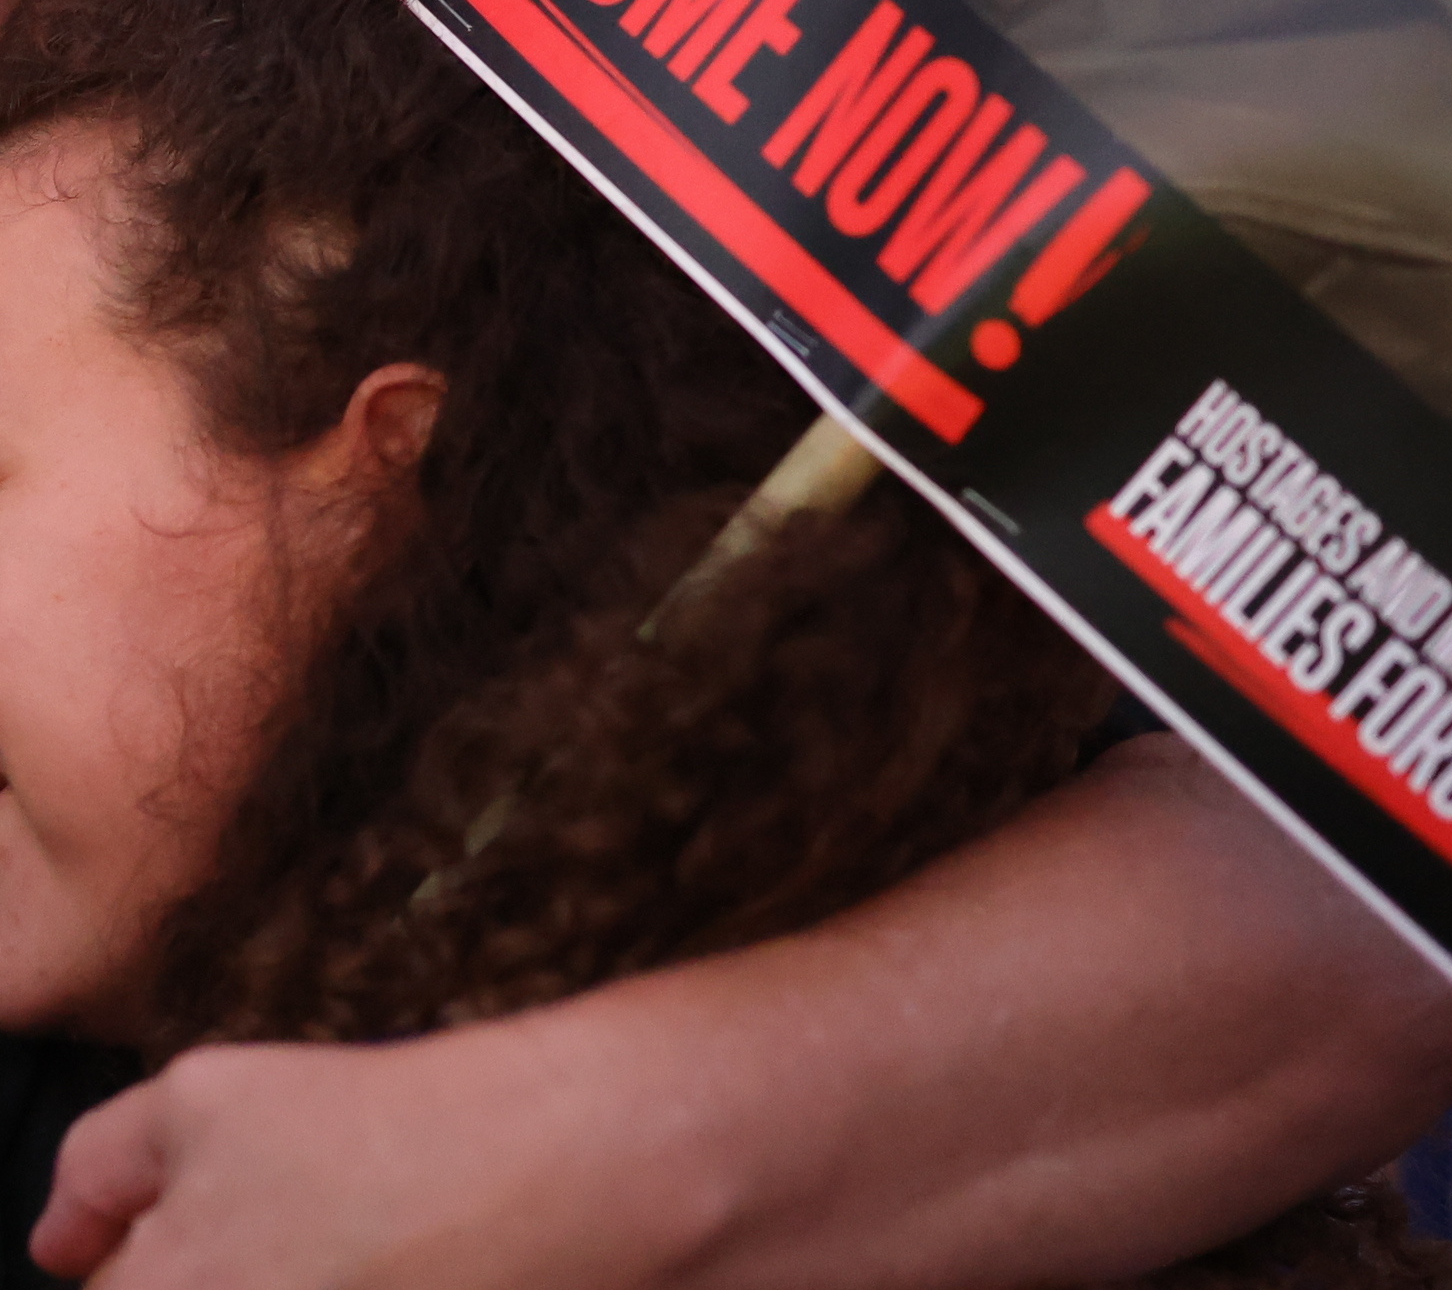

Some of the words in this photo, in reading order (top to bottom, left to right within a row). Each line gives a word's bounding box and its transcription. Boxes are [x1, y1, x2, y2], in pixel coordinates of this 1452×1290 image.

[761, 0, 1153, 370] NOW!
[1109, 435, 1377, 693] FAMILIES
[1176, 378, 1382, 575] HOSTAGES
